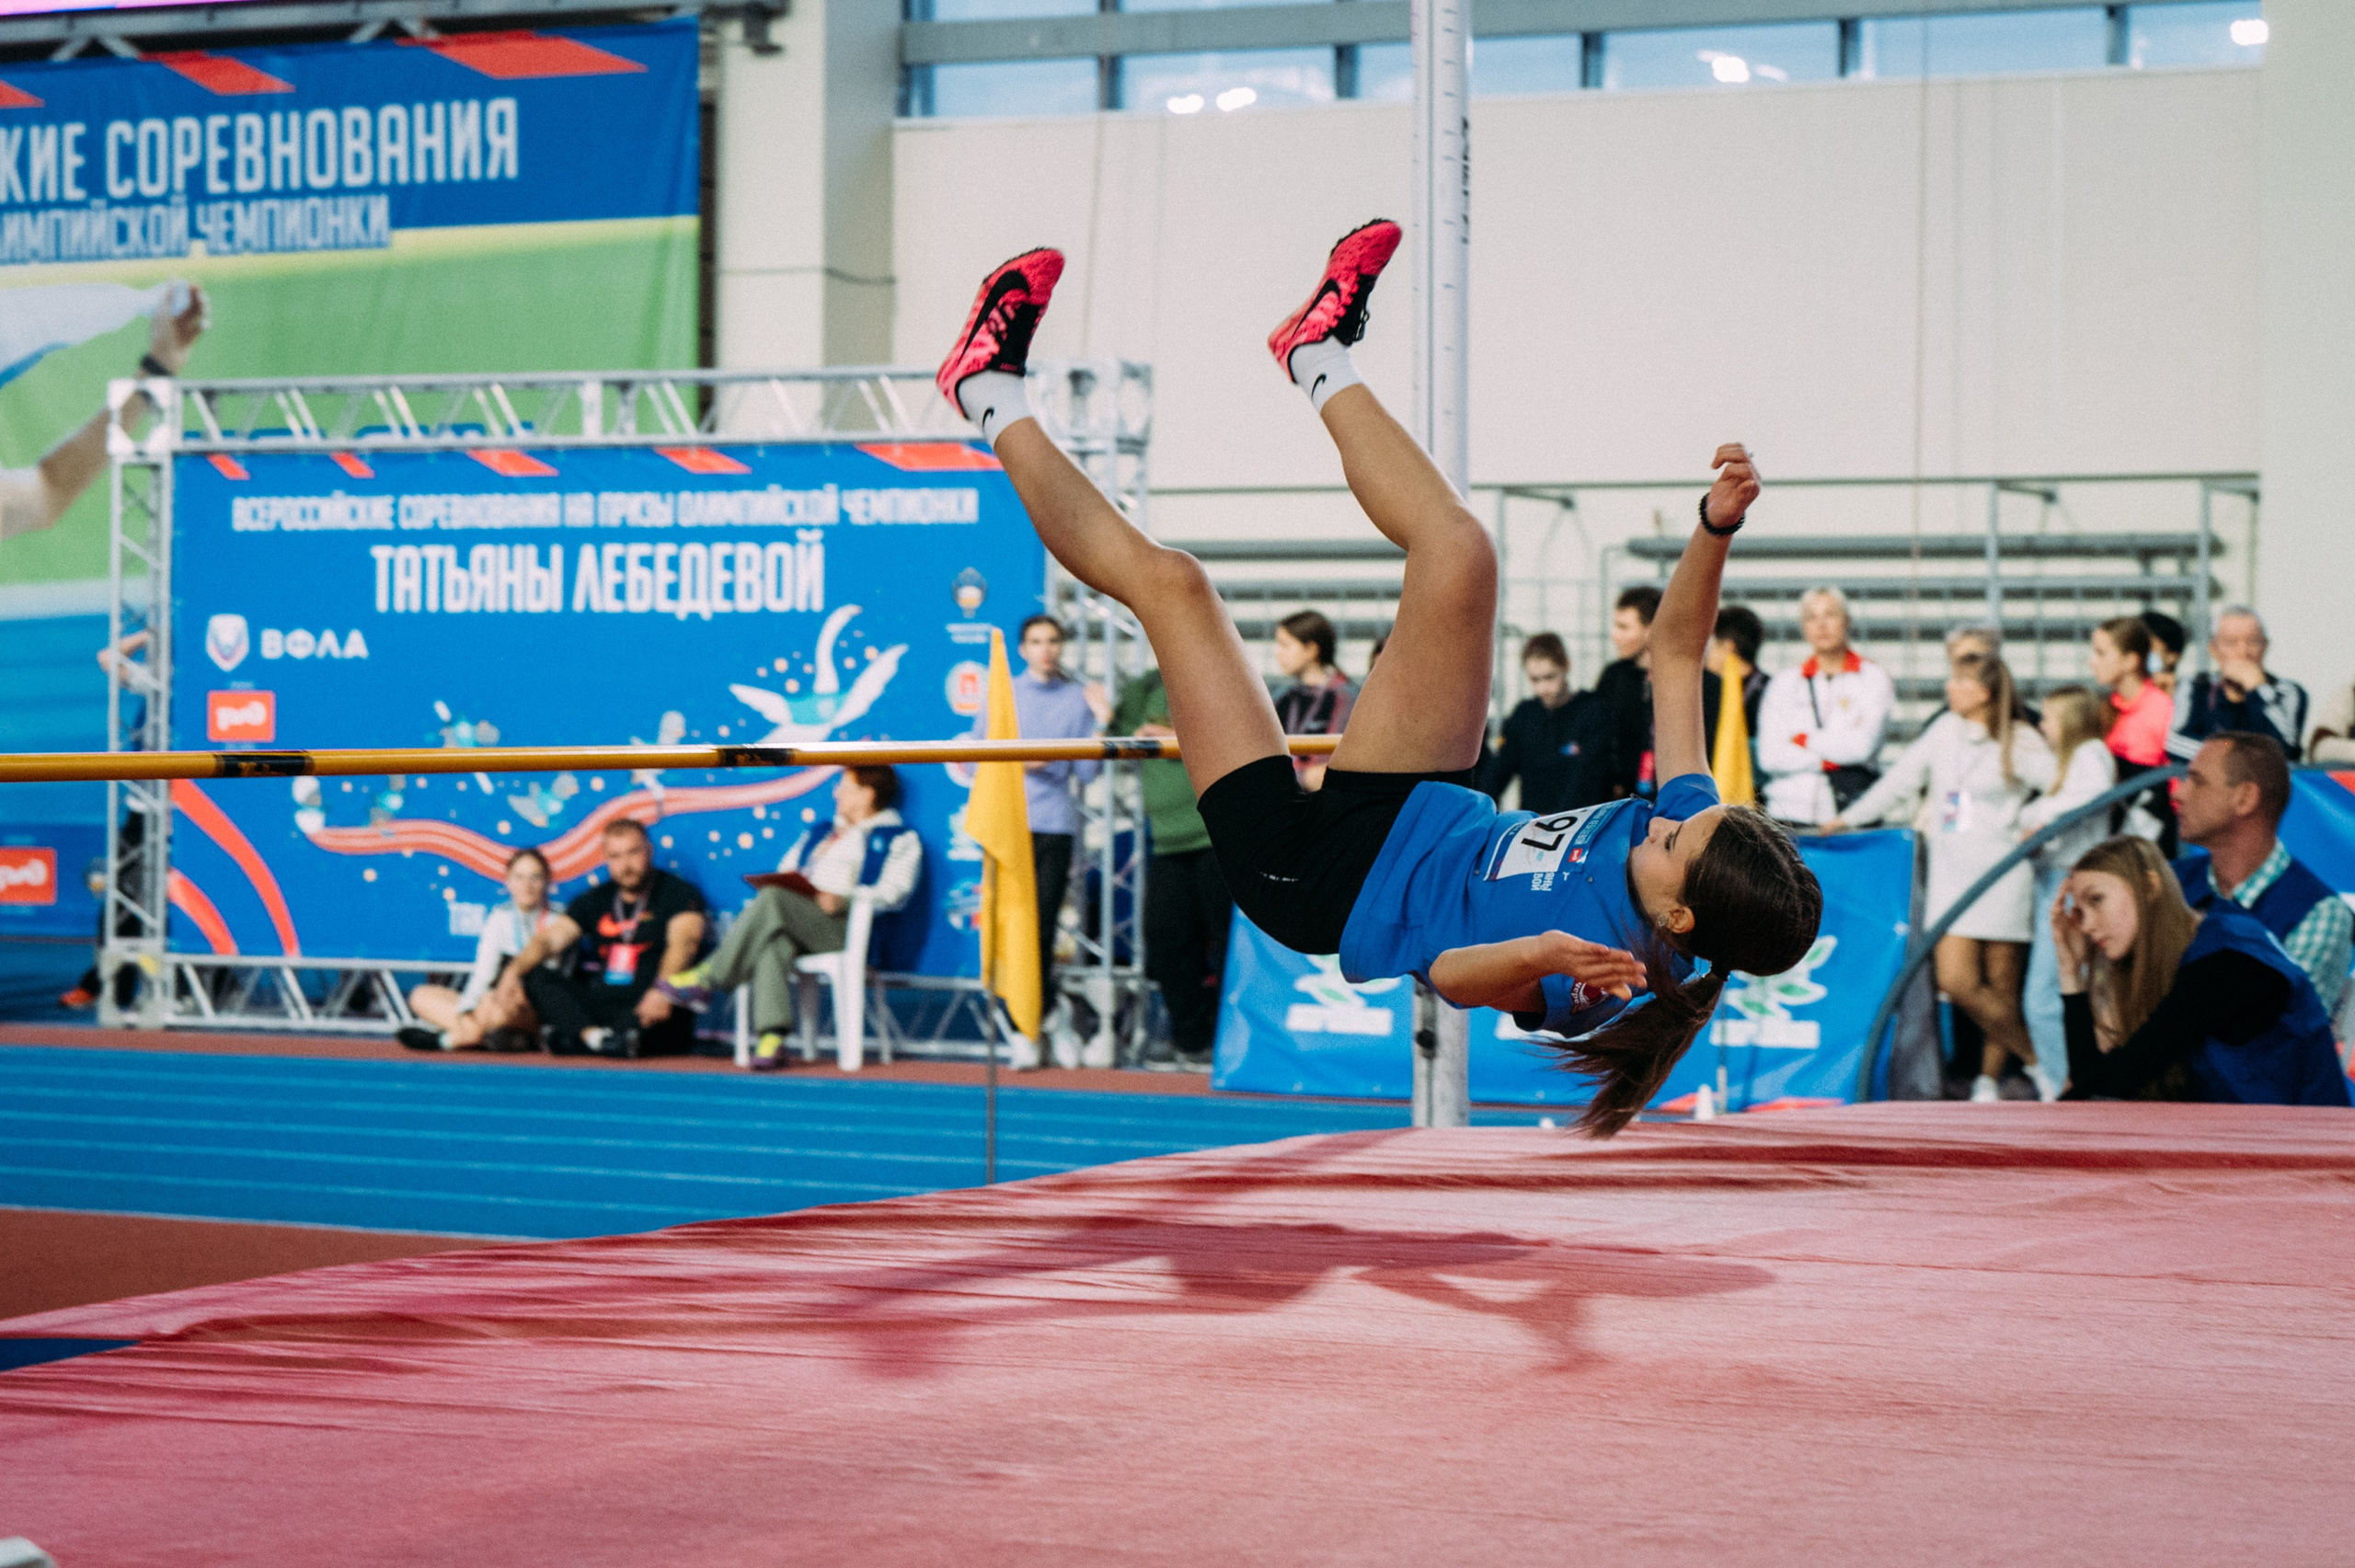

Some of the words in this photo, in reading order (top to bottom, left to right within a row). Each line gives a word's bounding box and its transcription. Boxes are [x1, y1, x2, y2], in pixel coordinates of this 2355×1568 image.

[105, 97, 519, 200] СОРЕВНОВАНИЯ
[196, 194, 390, 254] ЧЕМПИОНКИ
[370, 544, 565, 613] ТАТЬЯНЫ
[571, 528, 825, 622] ЛЕБЕДЕВОЙ
[260, 627, 370, 660] ВФЛА
[1521, 816, 1579, 852] 97
